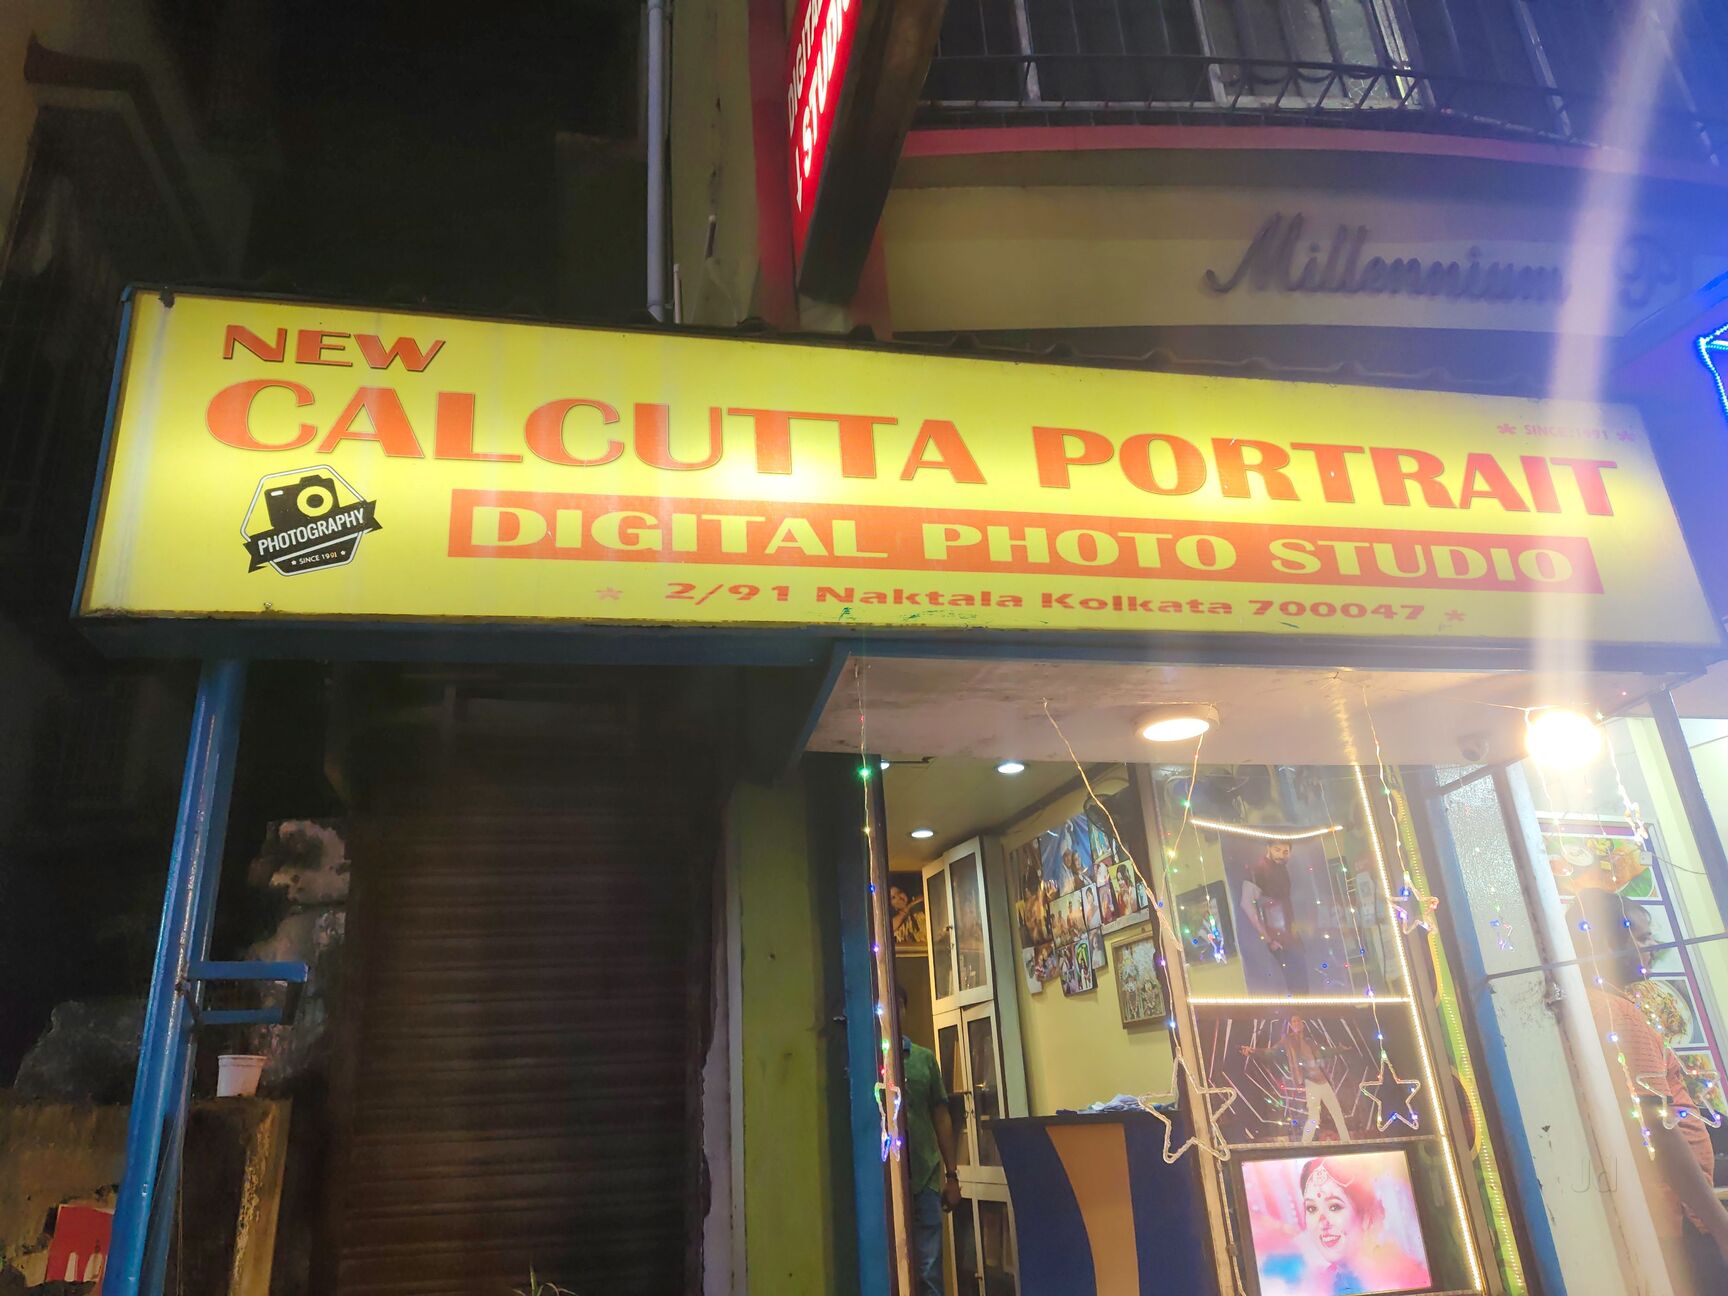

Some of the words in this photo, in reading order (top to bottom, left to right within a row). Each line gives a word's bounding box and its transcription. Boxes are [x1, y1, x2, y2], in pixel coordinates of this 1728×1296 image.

[222, 324, 446, 372] NEW
[205, 377, 987, 484] CALCUTTA
[1032, 425, 1618, 517] PORTRAIT
[257, 508, 365, 556] PHOTOGRAPHY
[470, 505, 888, 559] DIGITAL
[922, 522, 1236, 571] PHOTO
[1268, 536, 1575, 584] STUDIO
[298, 554, 321, 565] SINCE
[665, 582, 790, 606] 2/91
[815, 586, 1025, 608] Naktala
[1040, 591, 1233, 615] Kolkata
[1248, 599, 1425, 621] 700047
